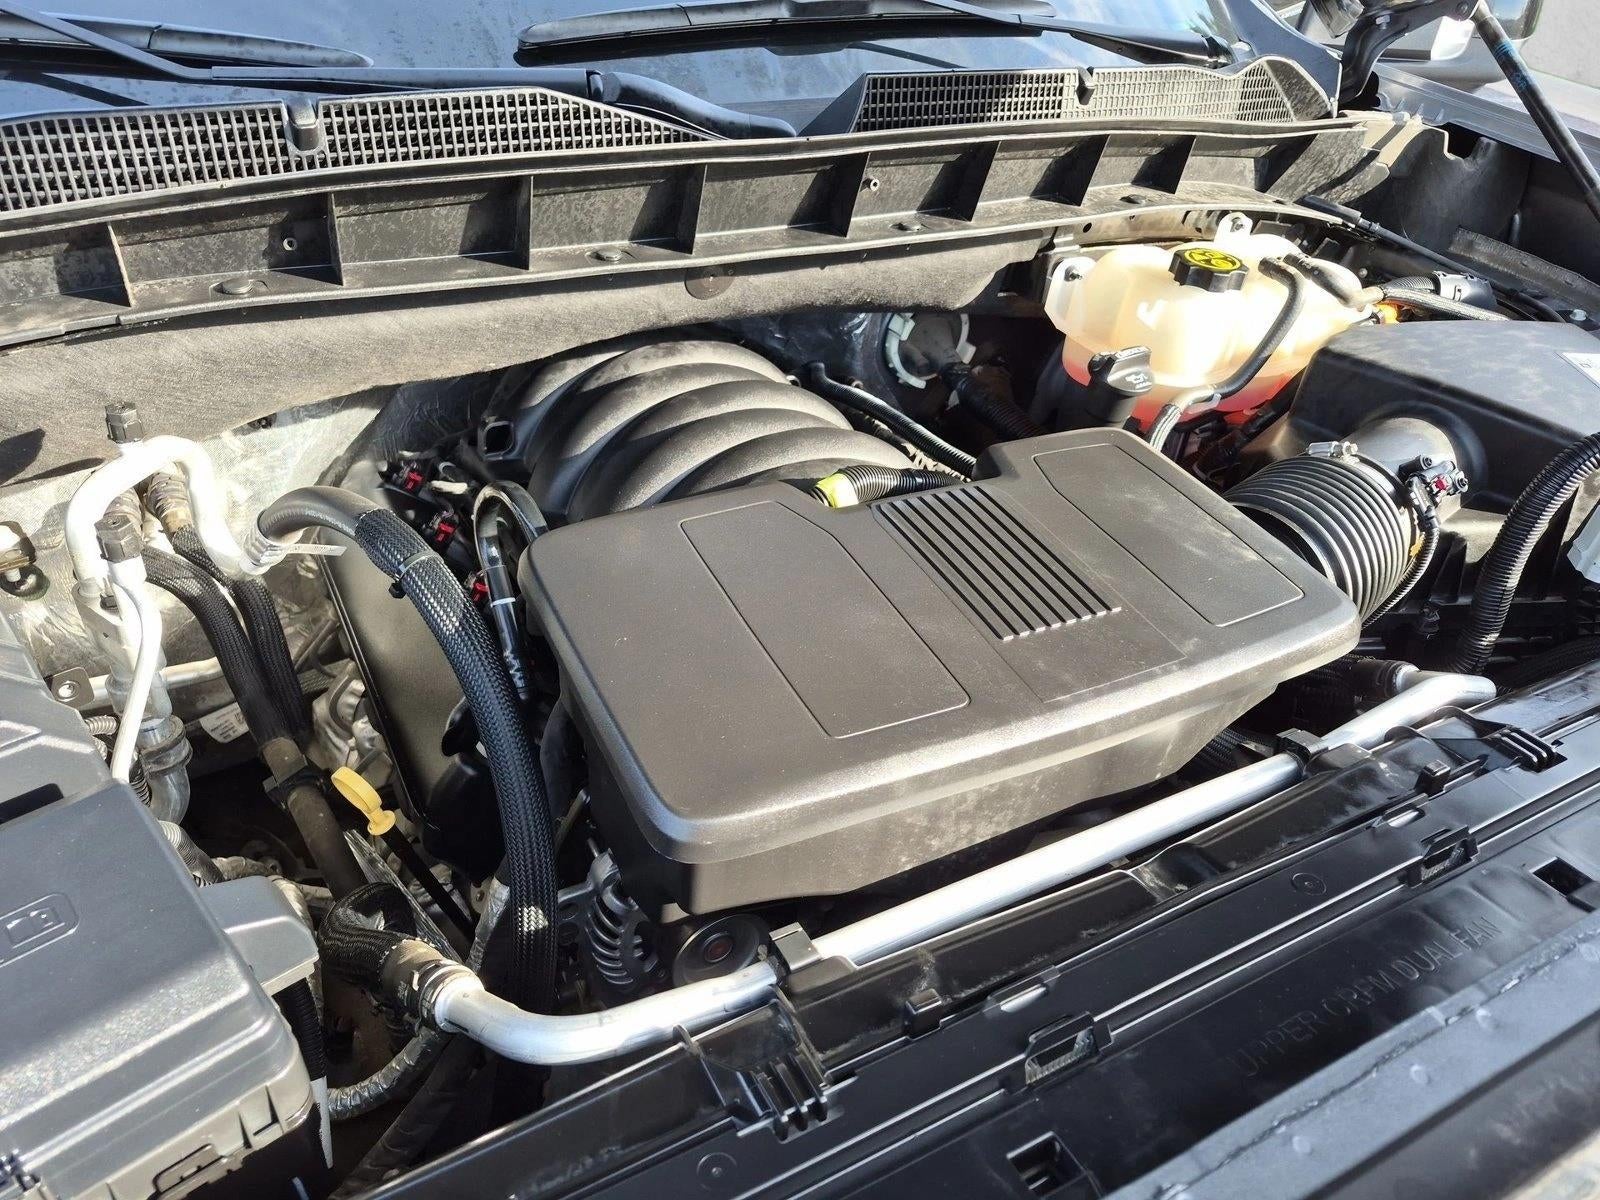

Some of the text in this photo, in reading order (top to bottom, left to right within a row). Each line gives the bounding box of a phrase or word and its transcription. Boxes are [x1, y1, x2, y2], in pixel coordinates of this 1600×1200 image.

[1226, 1010, 1330, 1078] UPPER
[1390, 940, 1463, 981] DUAL
[1448, 914, 1503, 951] FAN
